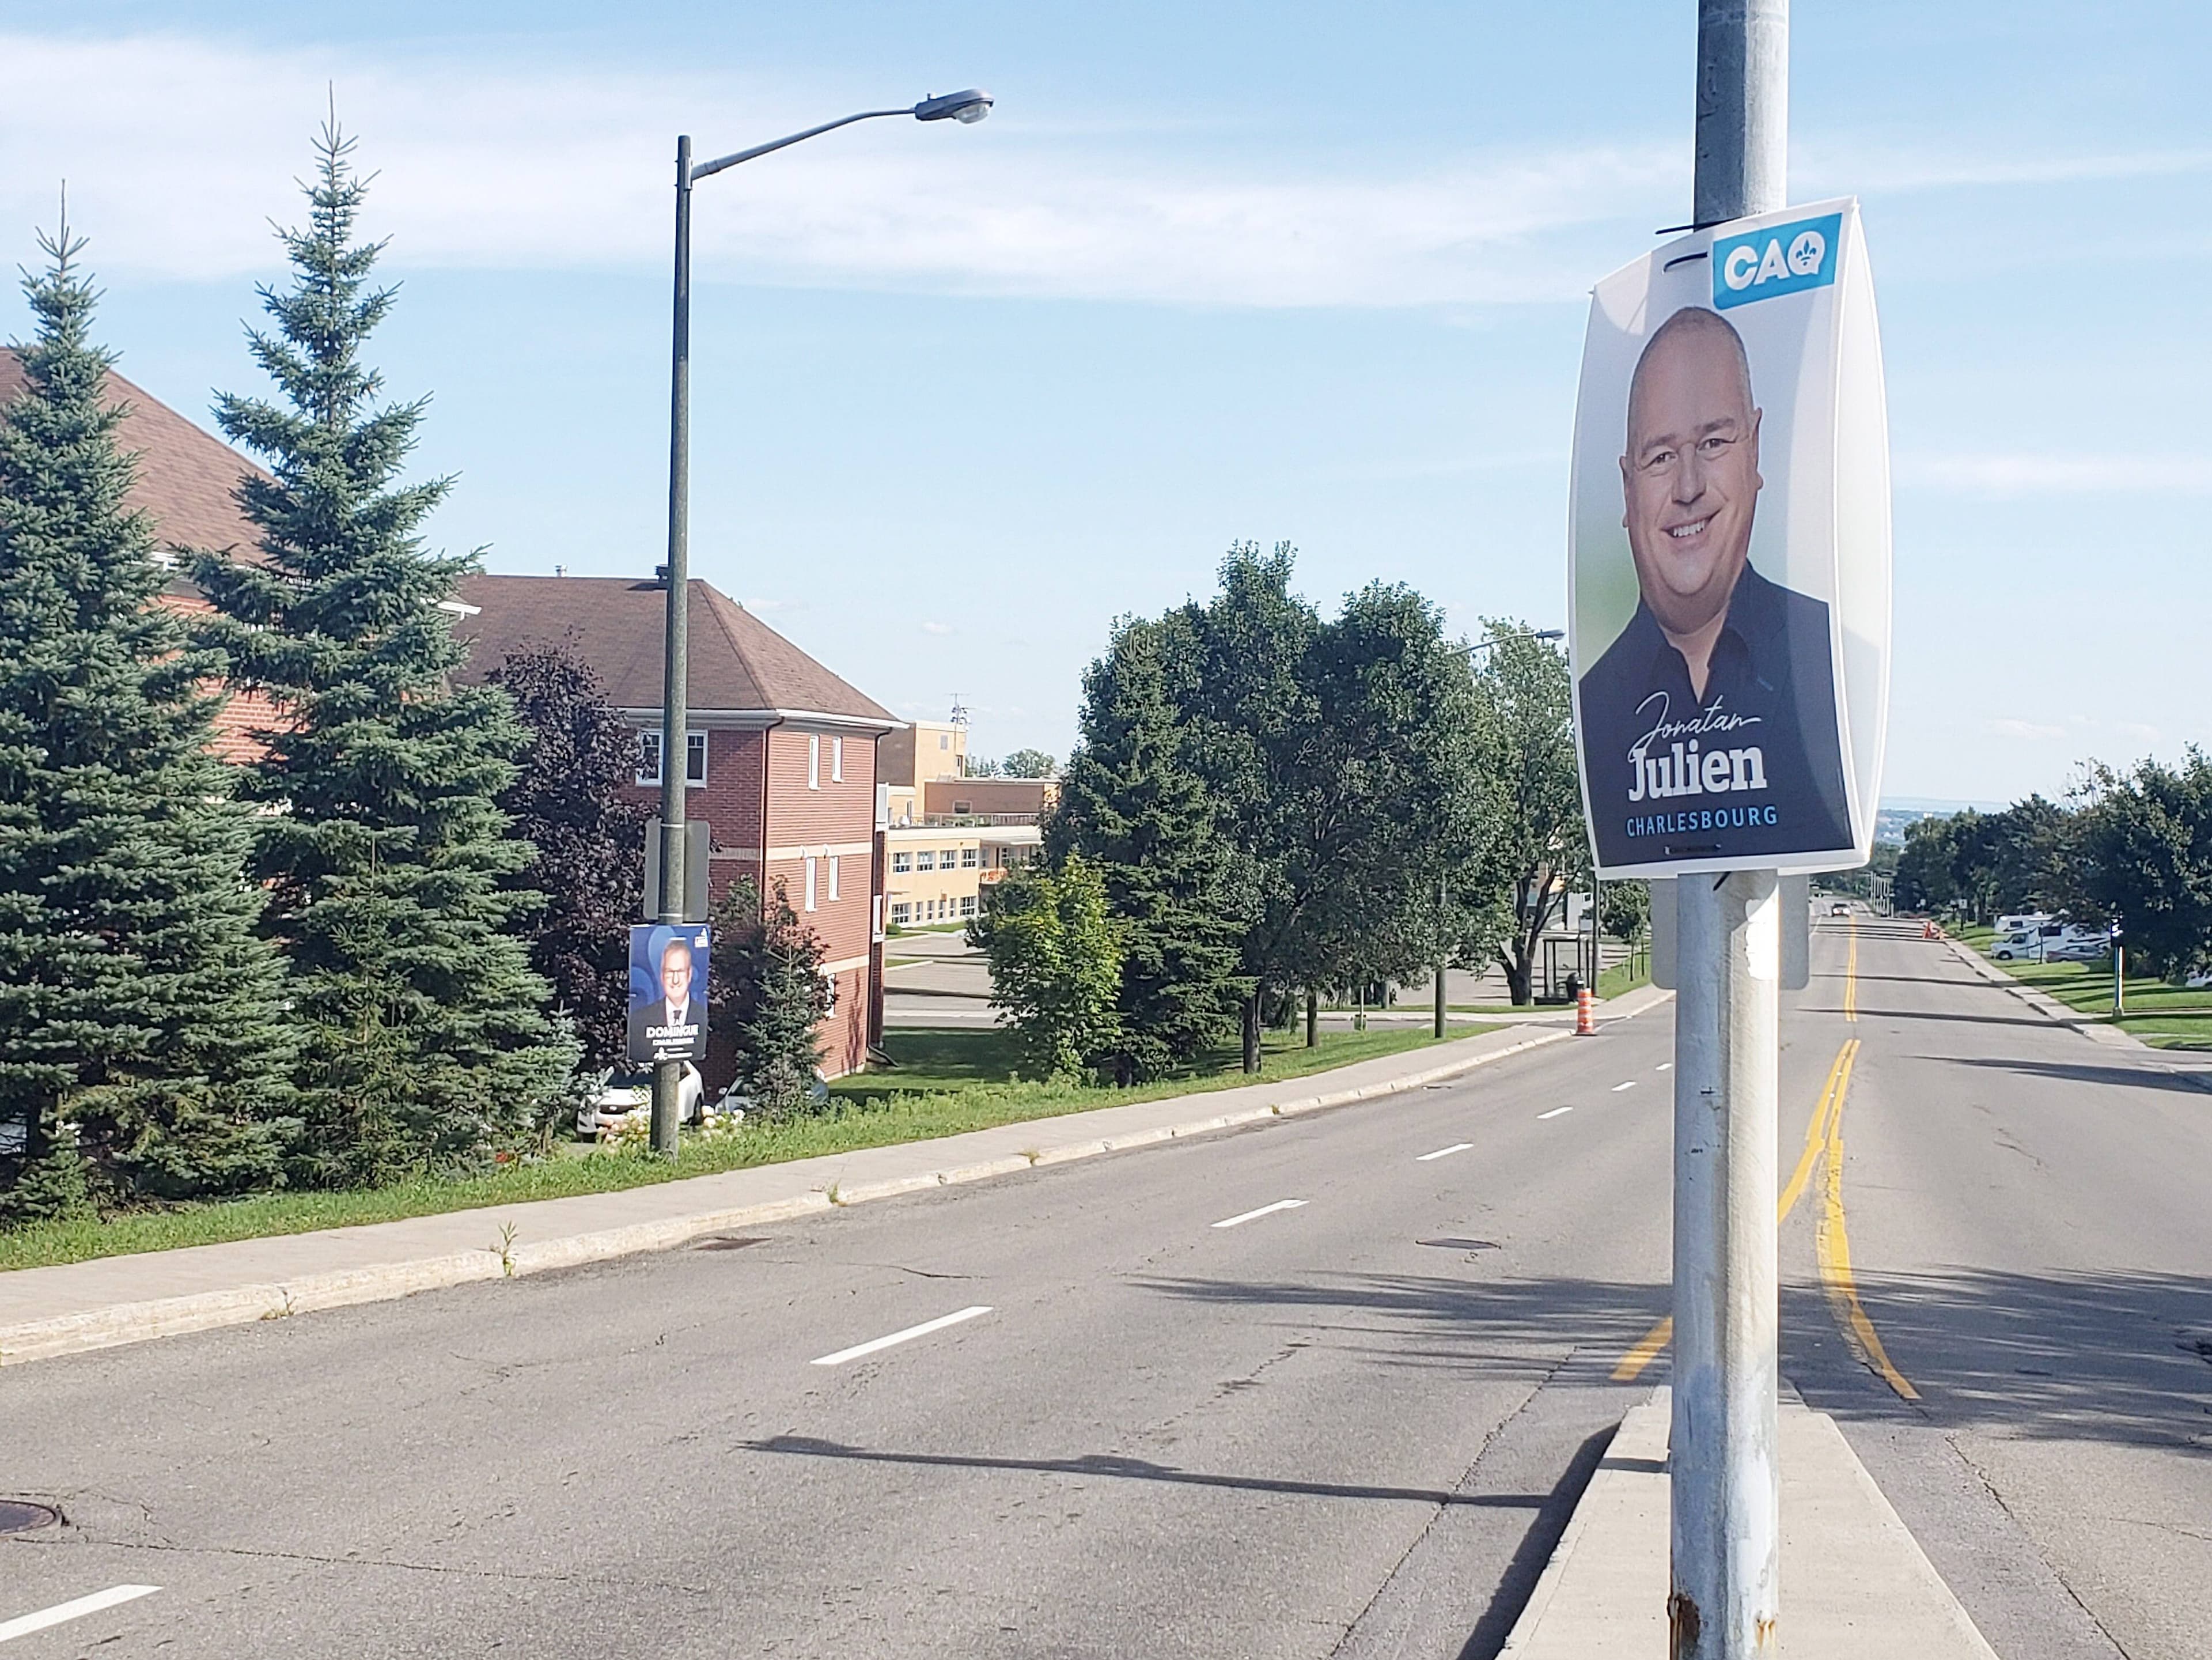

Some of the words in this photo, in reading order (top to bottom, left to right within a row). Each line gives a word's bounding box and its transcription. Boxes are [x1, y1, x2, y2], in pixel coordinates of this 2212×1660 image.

[1725, 230, 1825, 290] CAQ
[1628, 691, 1762, 762] Jonatan
[1628, 738, 1767, 801] Julien
[1626, 805, 1778, 837] CHARLESBOURG
